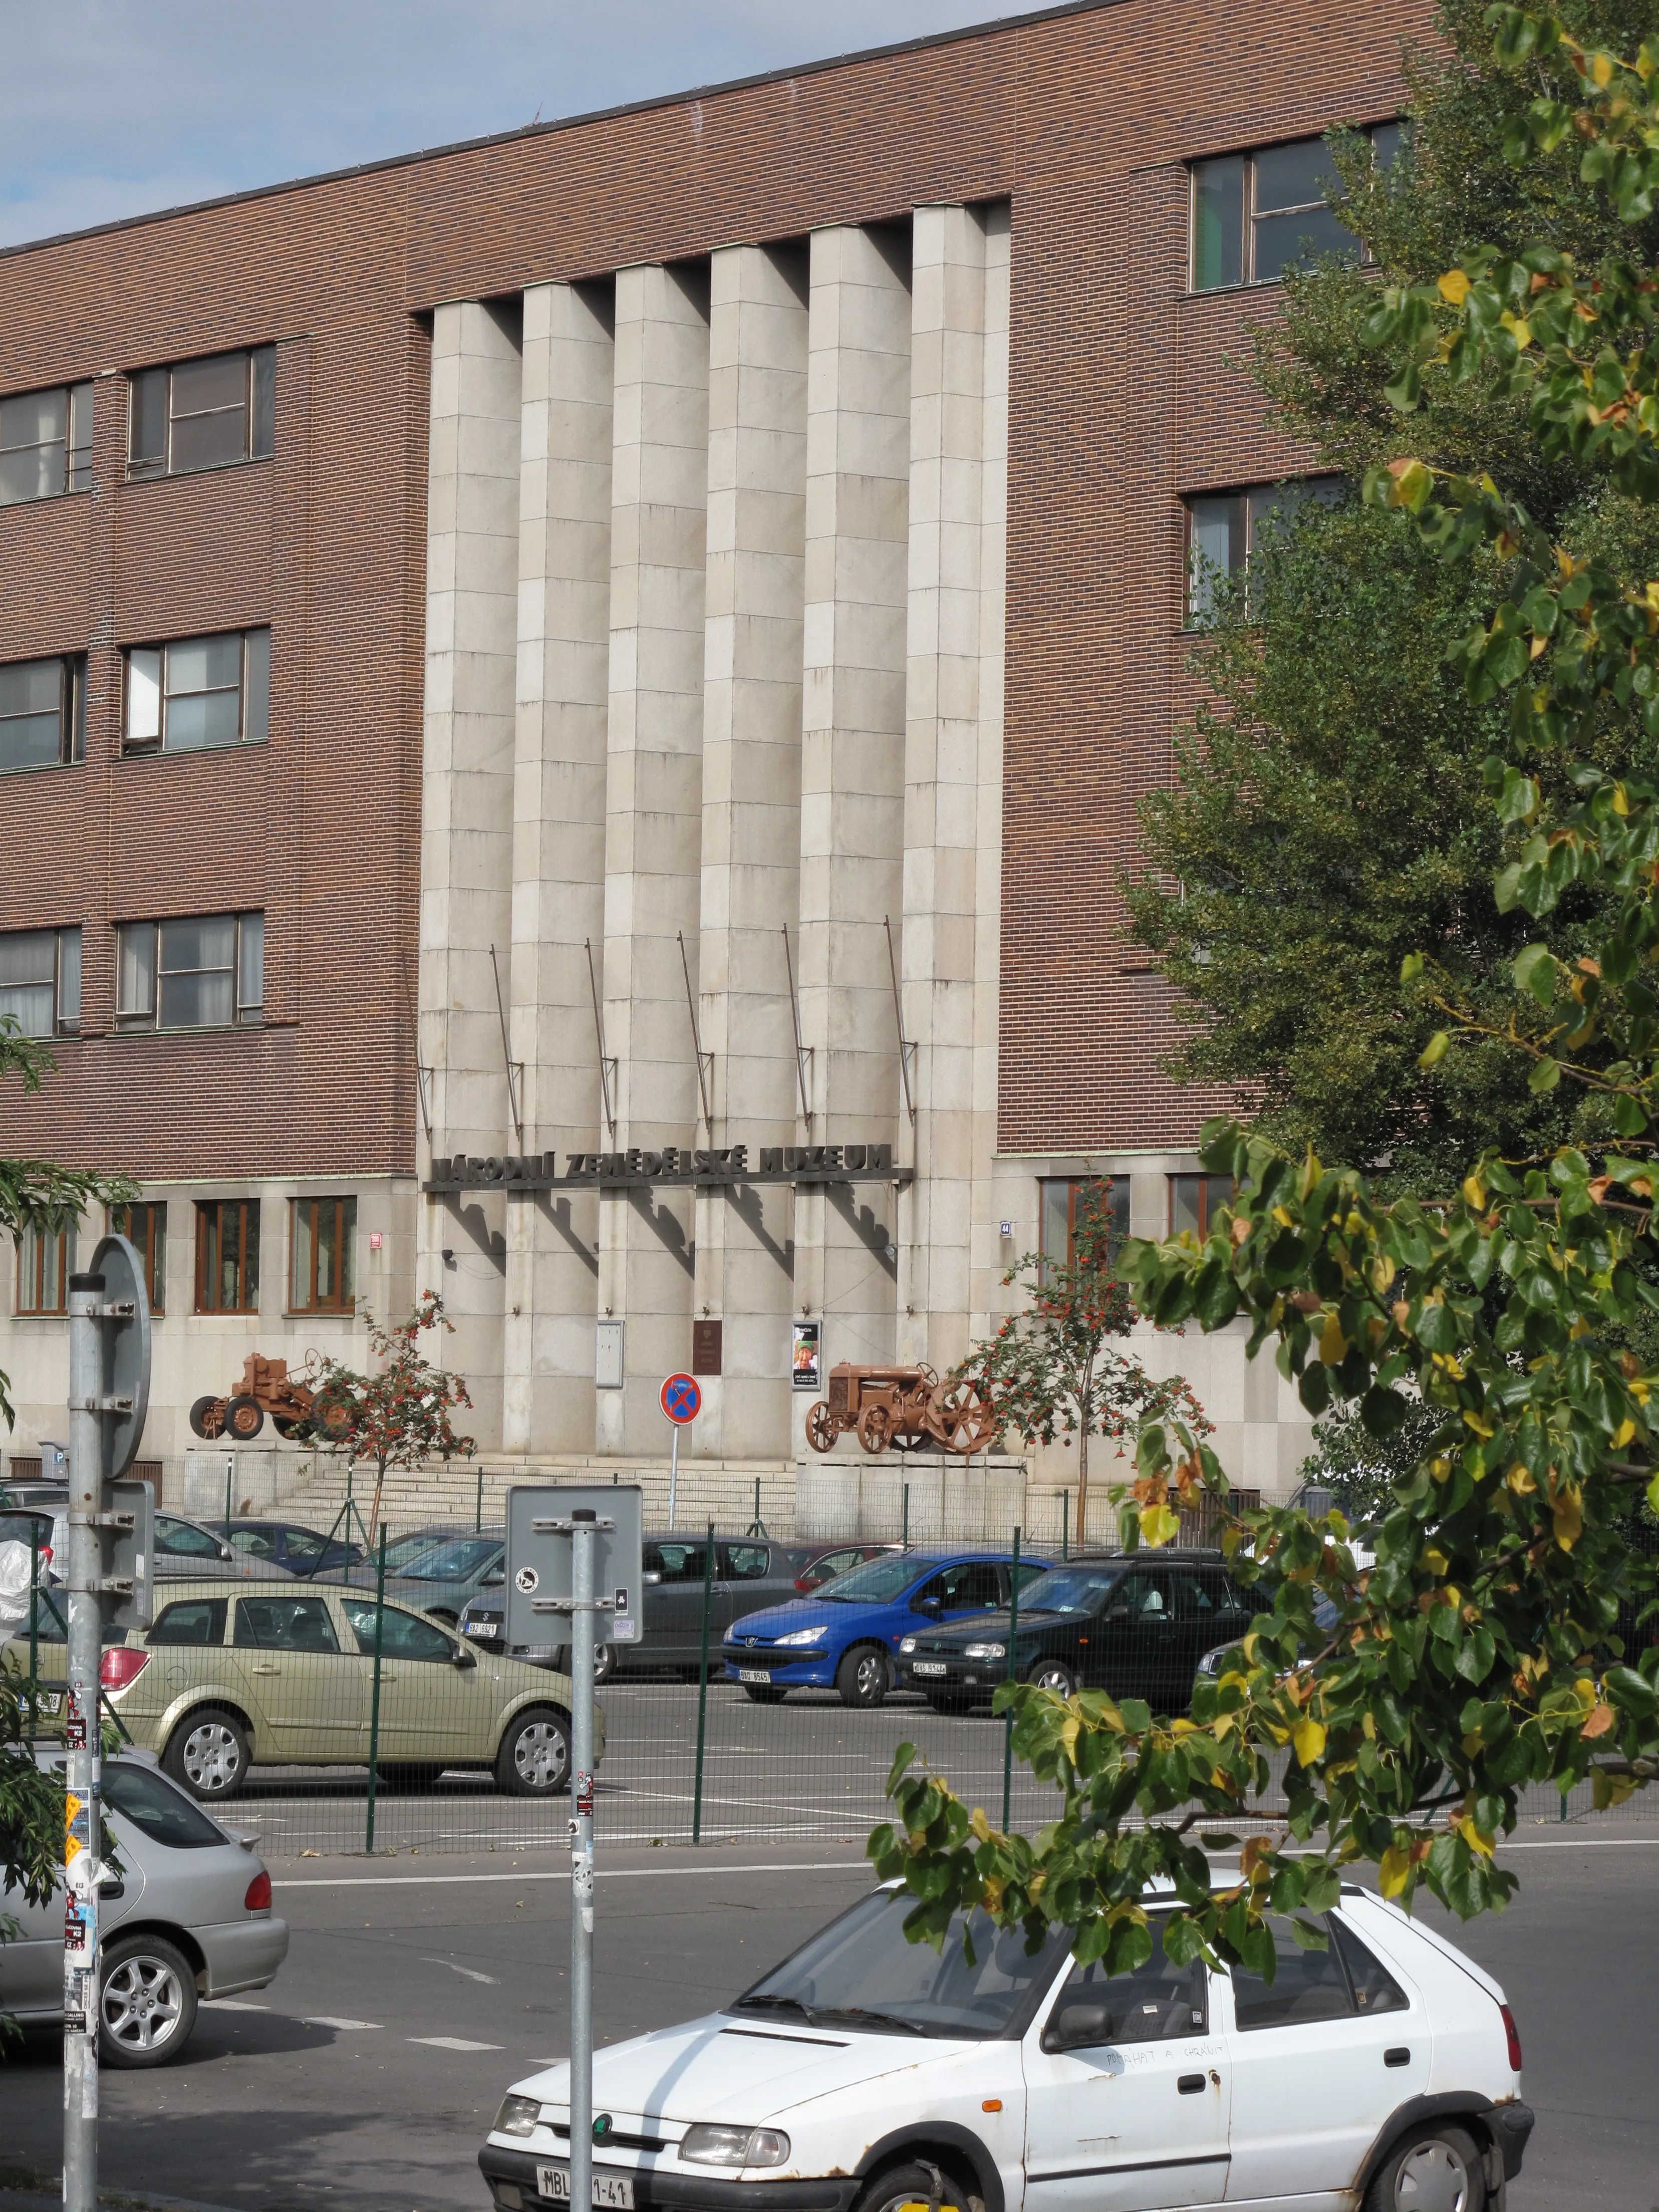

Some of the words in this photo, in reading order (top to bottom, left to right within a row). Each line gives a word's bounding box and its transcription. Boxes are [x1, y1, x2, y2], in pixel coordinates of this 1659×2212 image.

[431, 1151, 556, 1182] NÁRODNÍ
[566, 1145, 748, 1178] ZEMĚDĚLSKÉ
[759, 1144, 892, 1173] MUZEUM
[1002, 1225, 1008, 1233] 44
[481, 1624, 494, 1634] 6921
[1107, 2047, 1156, 2068] POMÁHAT
[1165, 2050, 1174, 2060] A
[543, 2169, 570, 2196] MBL
